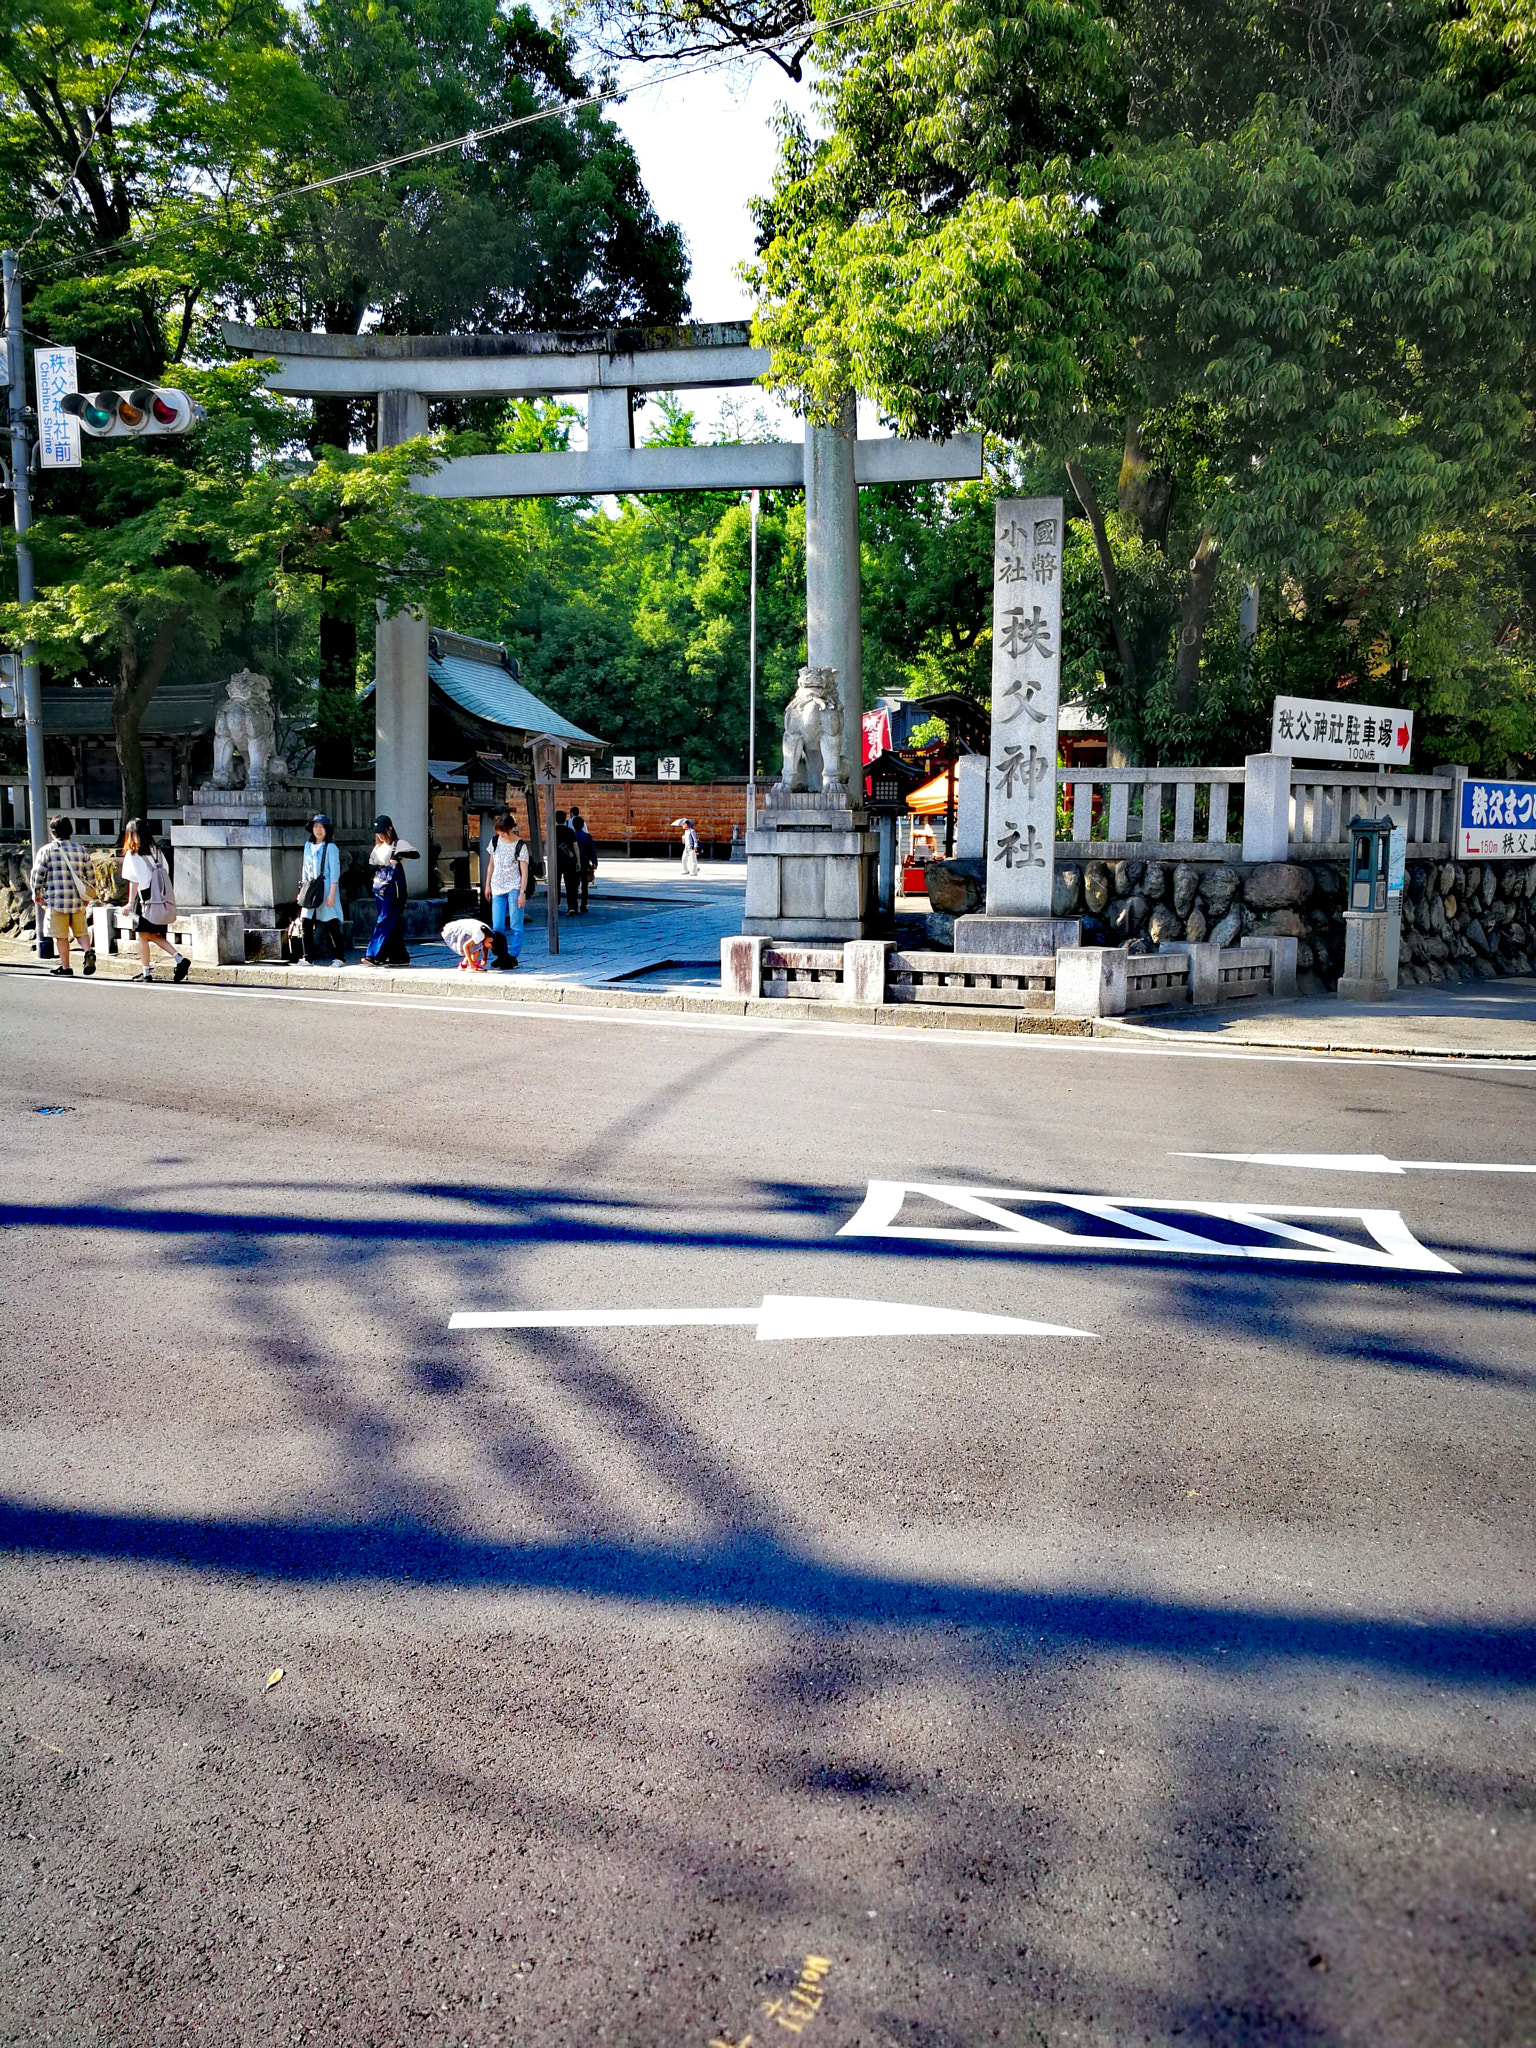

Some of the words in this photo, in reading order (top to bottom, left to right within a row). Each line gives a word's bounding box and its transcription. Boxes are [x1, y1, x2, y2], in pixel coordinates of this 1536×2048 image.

[40, 362, 51, 412] Chichibu
[44, 418, 53, 455] Shrine
[993, 605, 1055, 870] 秩父神社
[1278, 708, 1393, 748] 秩父神社駐車場
[1480, 839, 1498, 854] 150m
